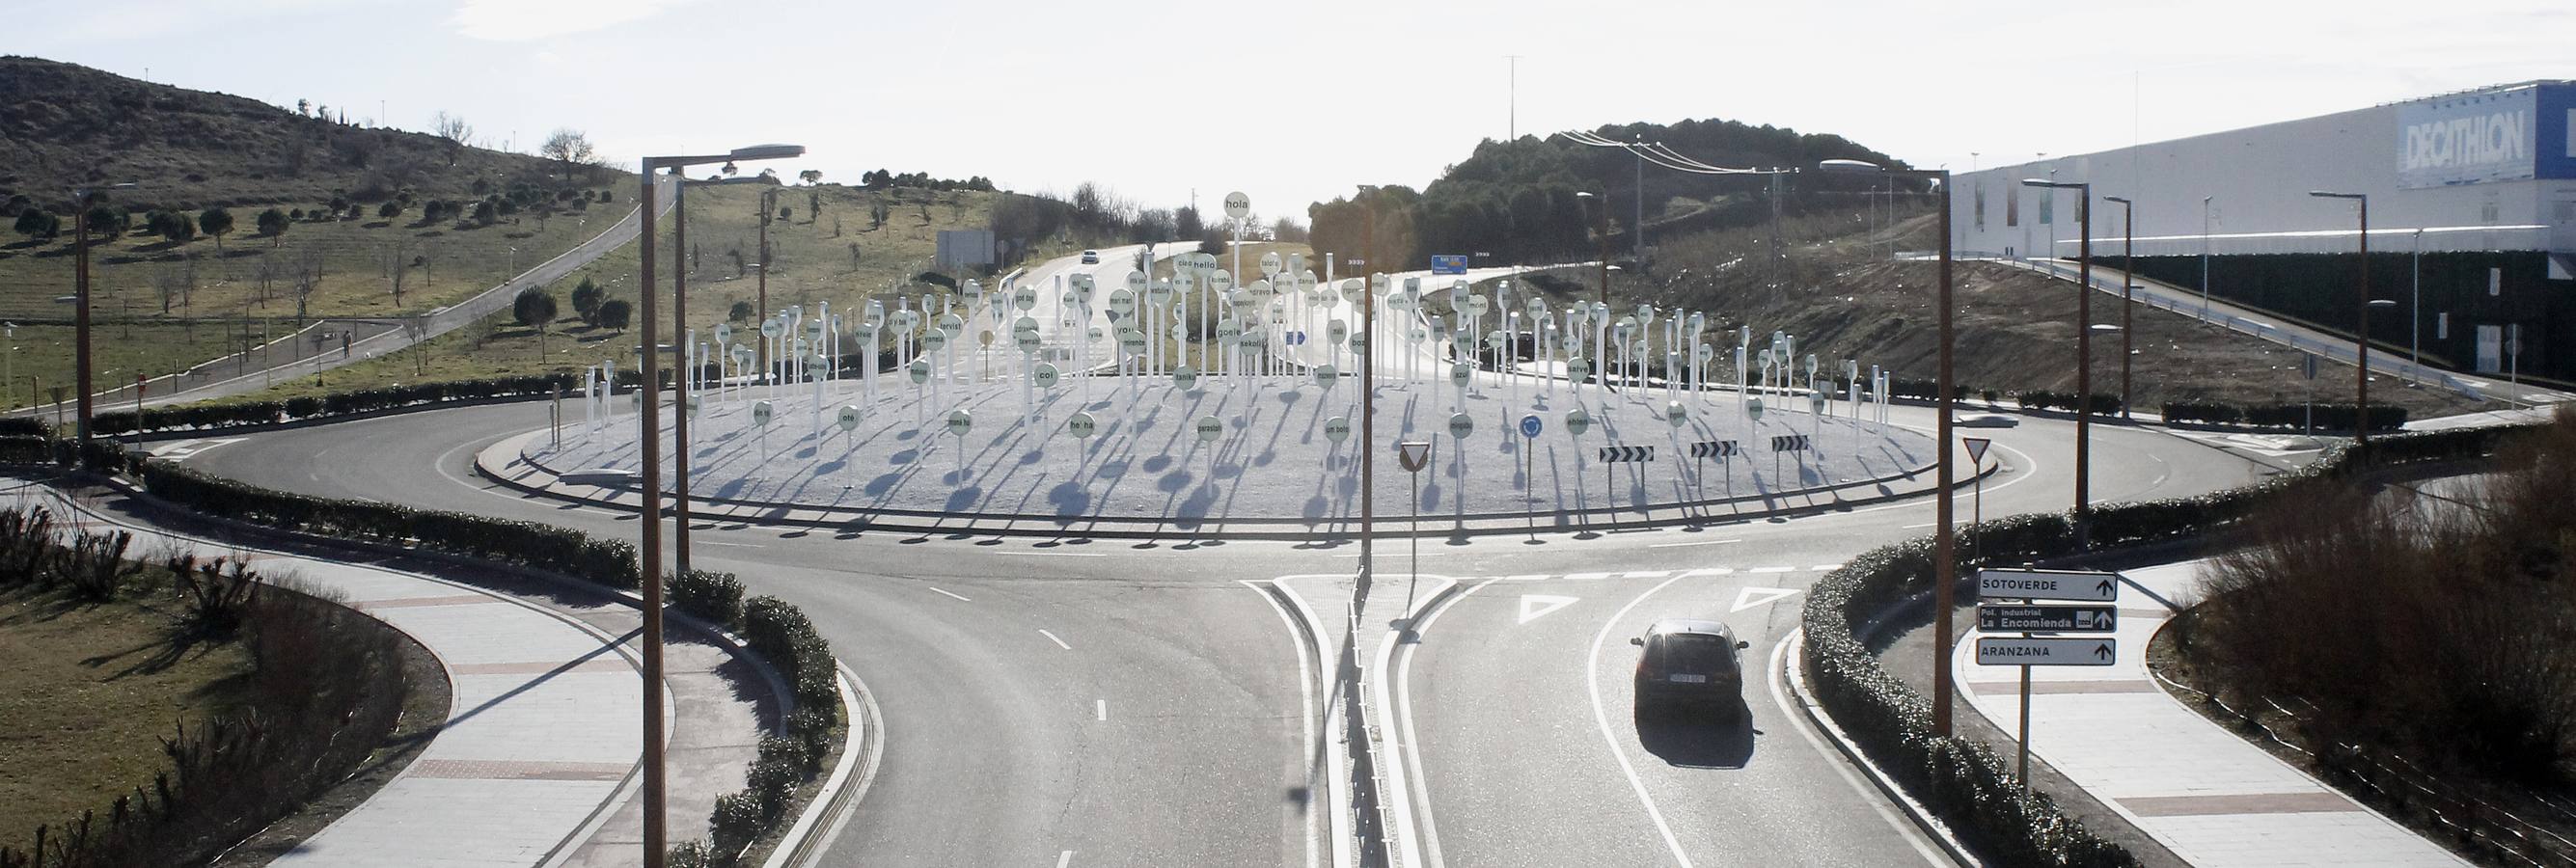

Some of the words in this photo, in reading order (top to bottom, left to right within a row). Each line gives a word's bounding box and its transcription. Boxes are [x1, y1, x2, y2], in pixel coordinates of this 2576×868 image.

[2407, 110, 2525, 170] DECATHLON
[1225, 199, 1248, 208] hola
[940, 322, 961, 331] tervist
[1568, 364, 1588, 373] salve
[1983, 580, 2057, 590] SOTOVERDE
[1982, 618, 1994, 627] La
[2001, 618, 2071, 628] Encomienda
[1981, 647, 2050, 657] ARANZANA
